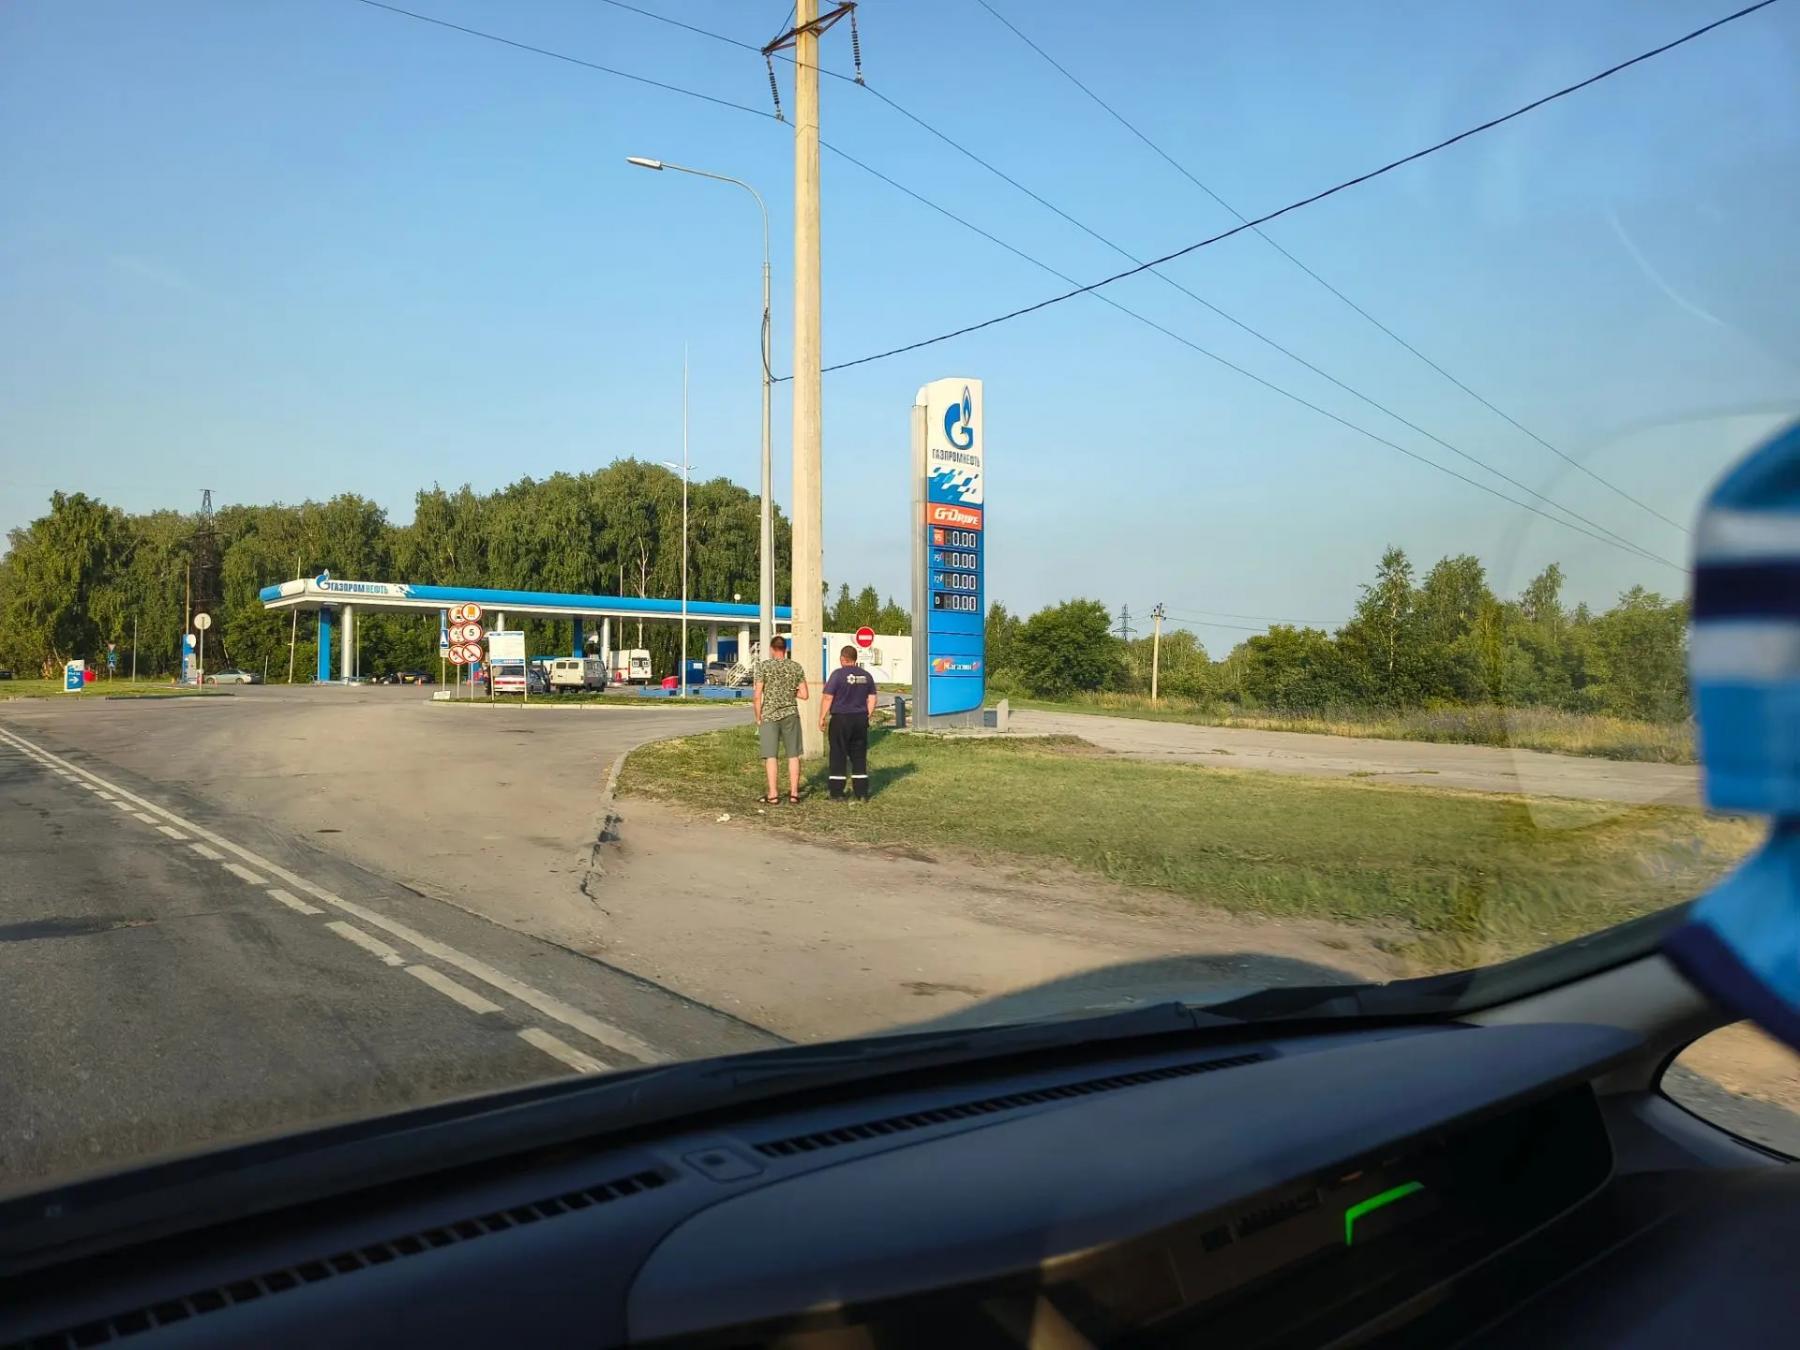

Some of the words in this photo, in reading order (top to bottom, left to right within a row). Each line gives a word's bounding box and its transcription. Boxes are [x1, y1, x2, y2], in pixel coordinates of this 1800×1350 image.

[931, 448, 980, 467] ГАЗПРОМНЕФТЬ
[952, 531, 976, 548] 0.00
[952, 552, 976, 569] 0.00
[330, 582, 389, 594] ГАЗПРОМНЕФТЬ
[952, 573, 976, 590] 0.00
[952, 595, 976, 612] 0.00
[468, 628, 475, 637] 5
